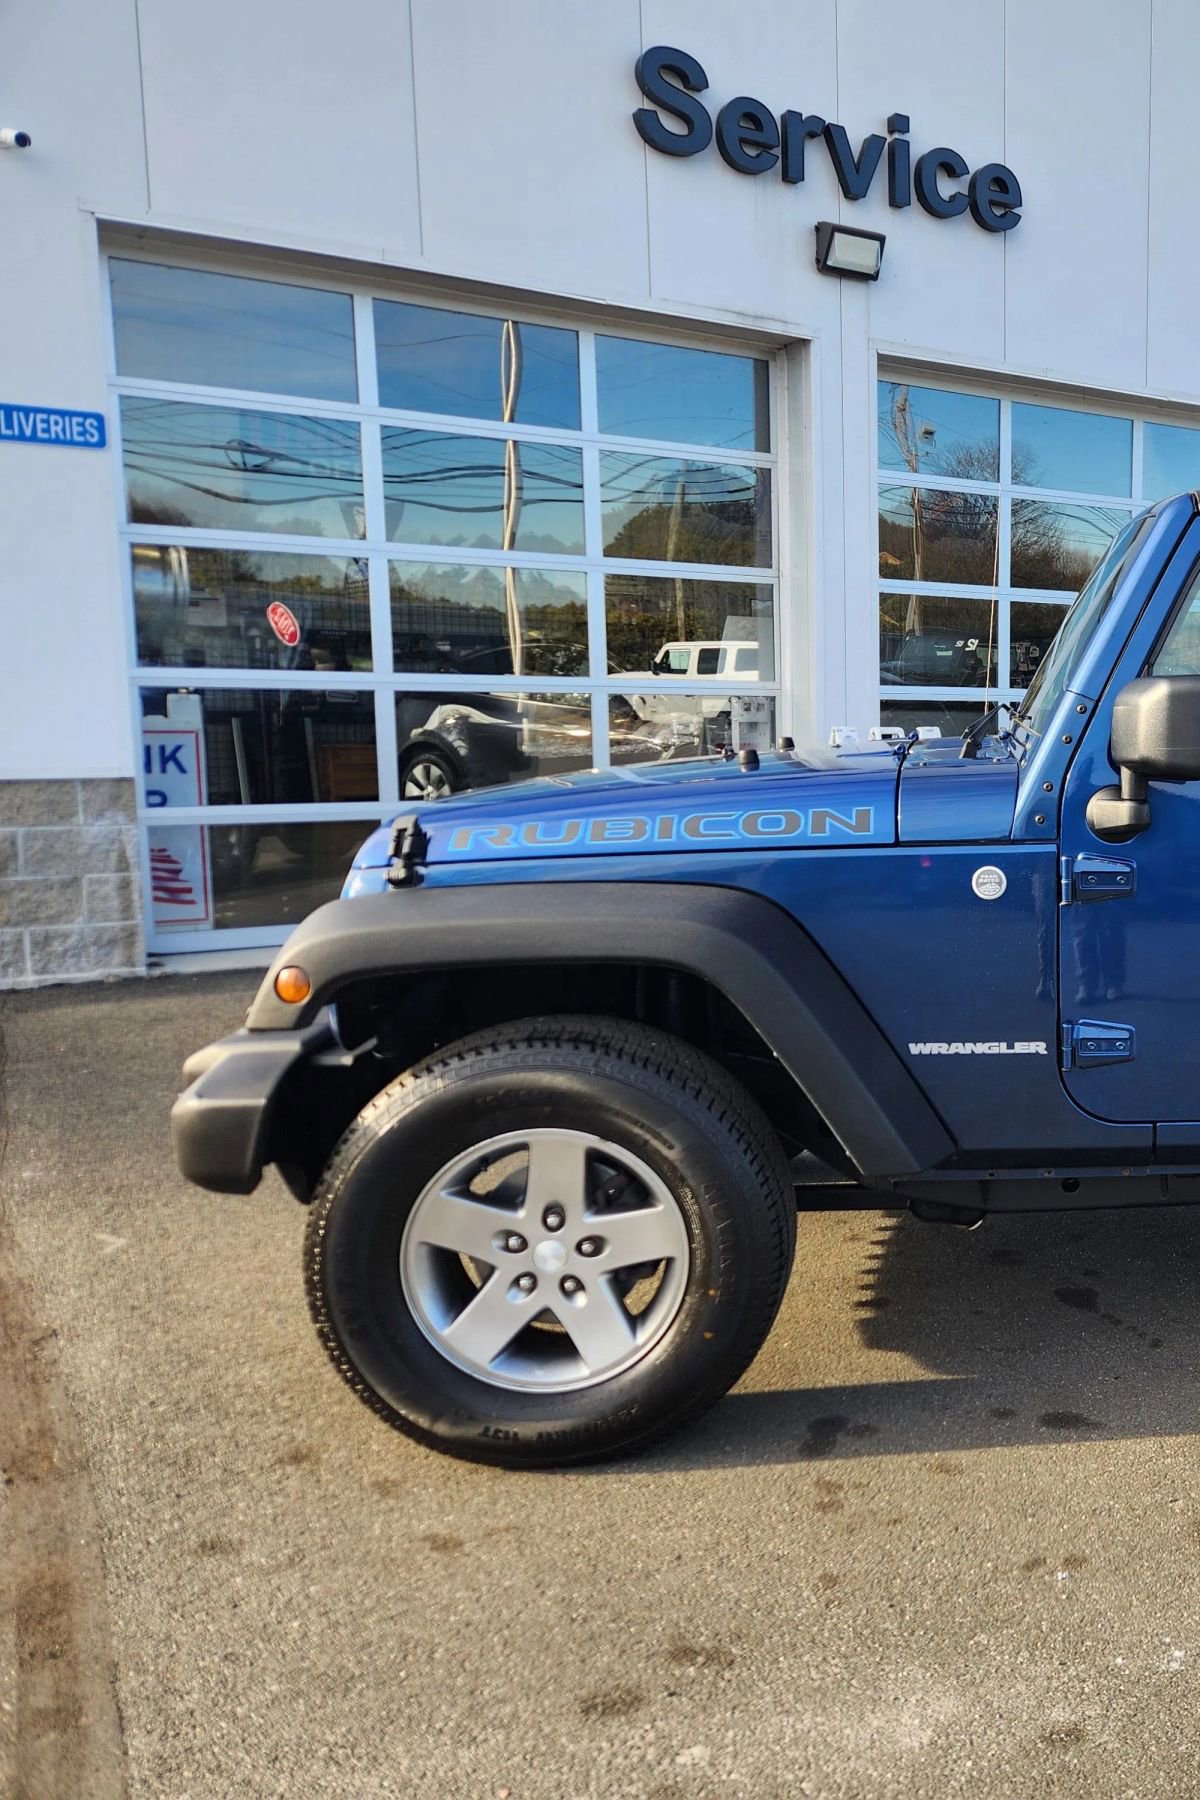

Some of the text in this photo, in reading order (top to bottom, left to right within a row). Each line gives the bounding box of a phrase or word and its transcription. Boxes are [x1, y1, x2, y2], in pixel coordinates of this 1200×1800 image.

[632, 45, 1023, 233] Service
[0, 410, 99, 443] LIVERIES
[448, 806, 875, 851] RUBICON
[908, 1041, 1048, 1055] WRANGLER
